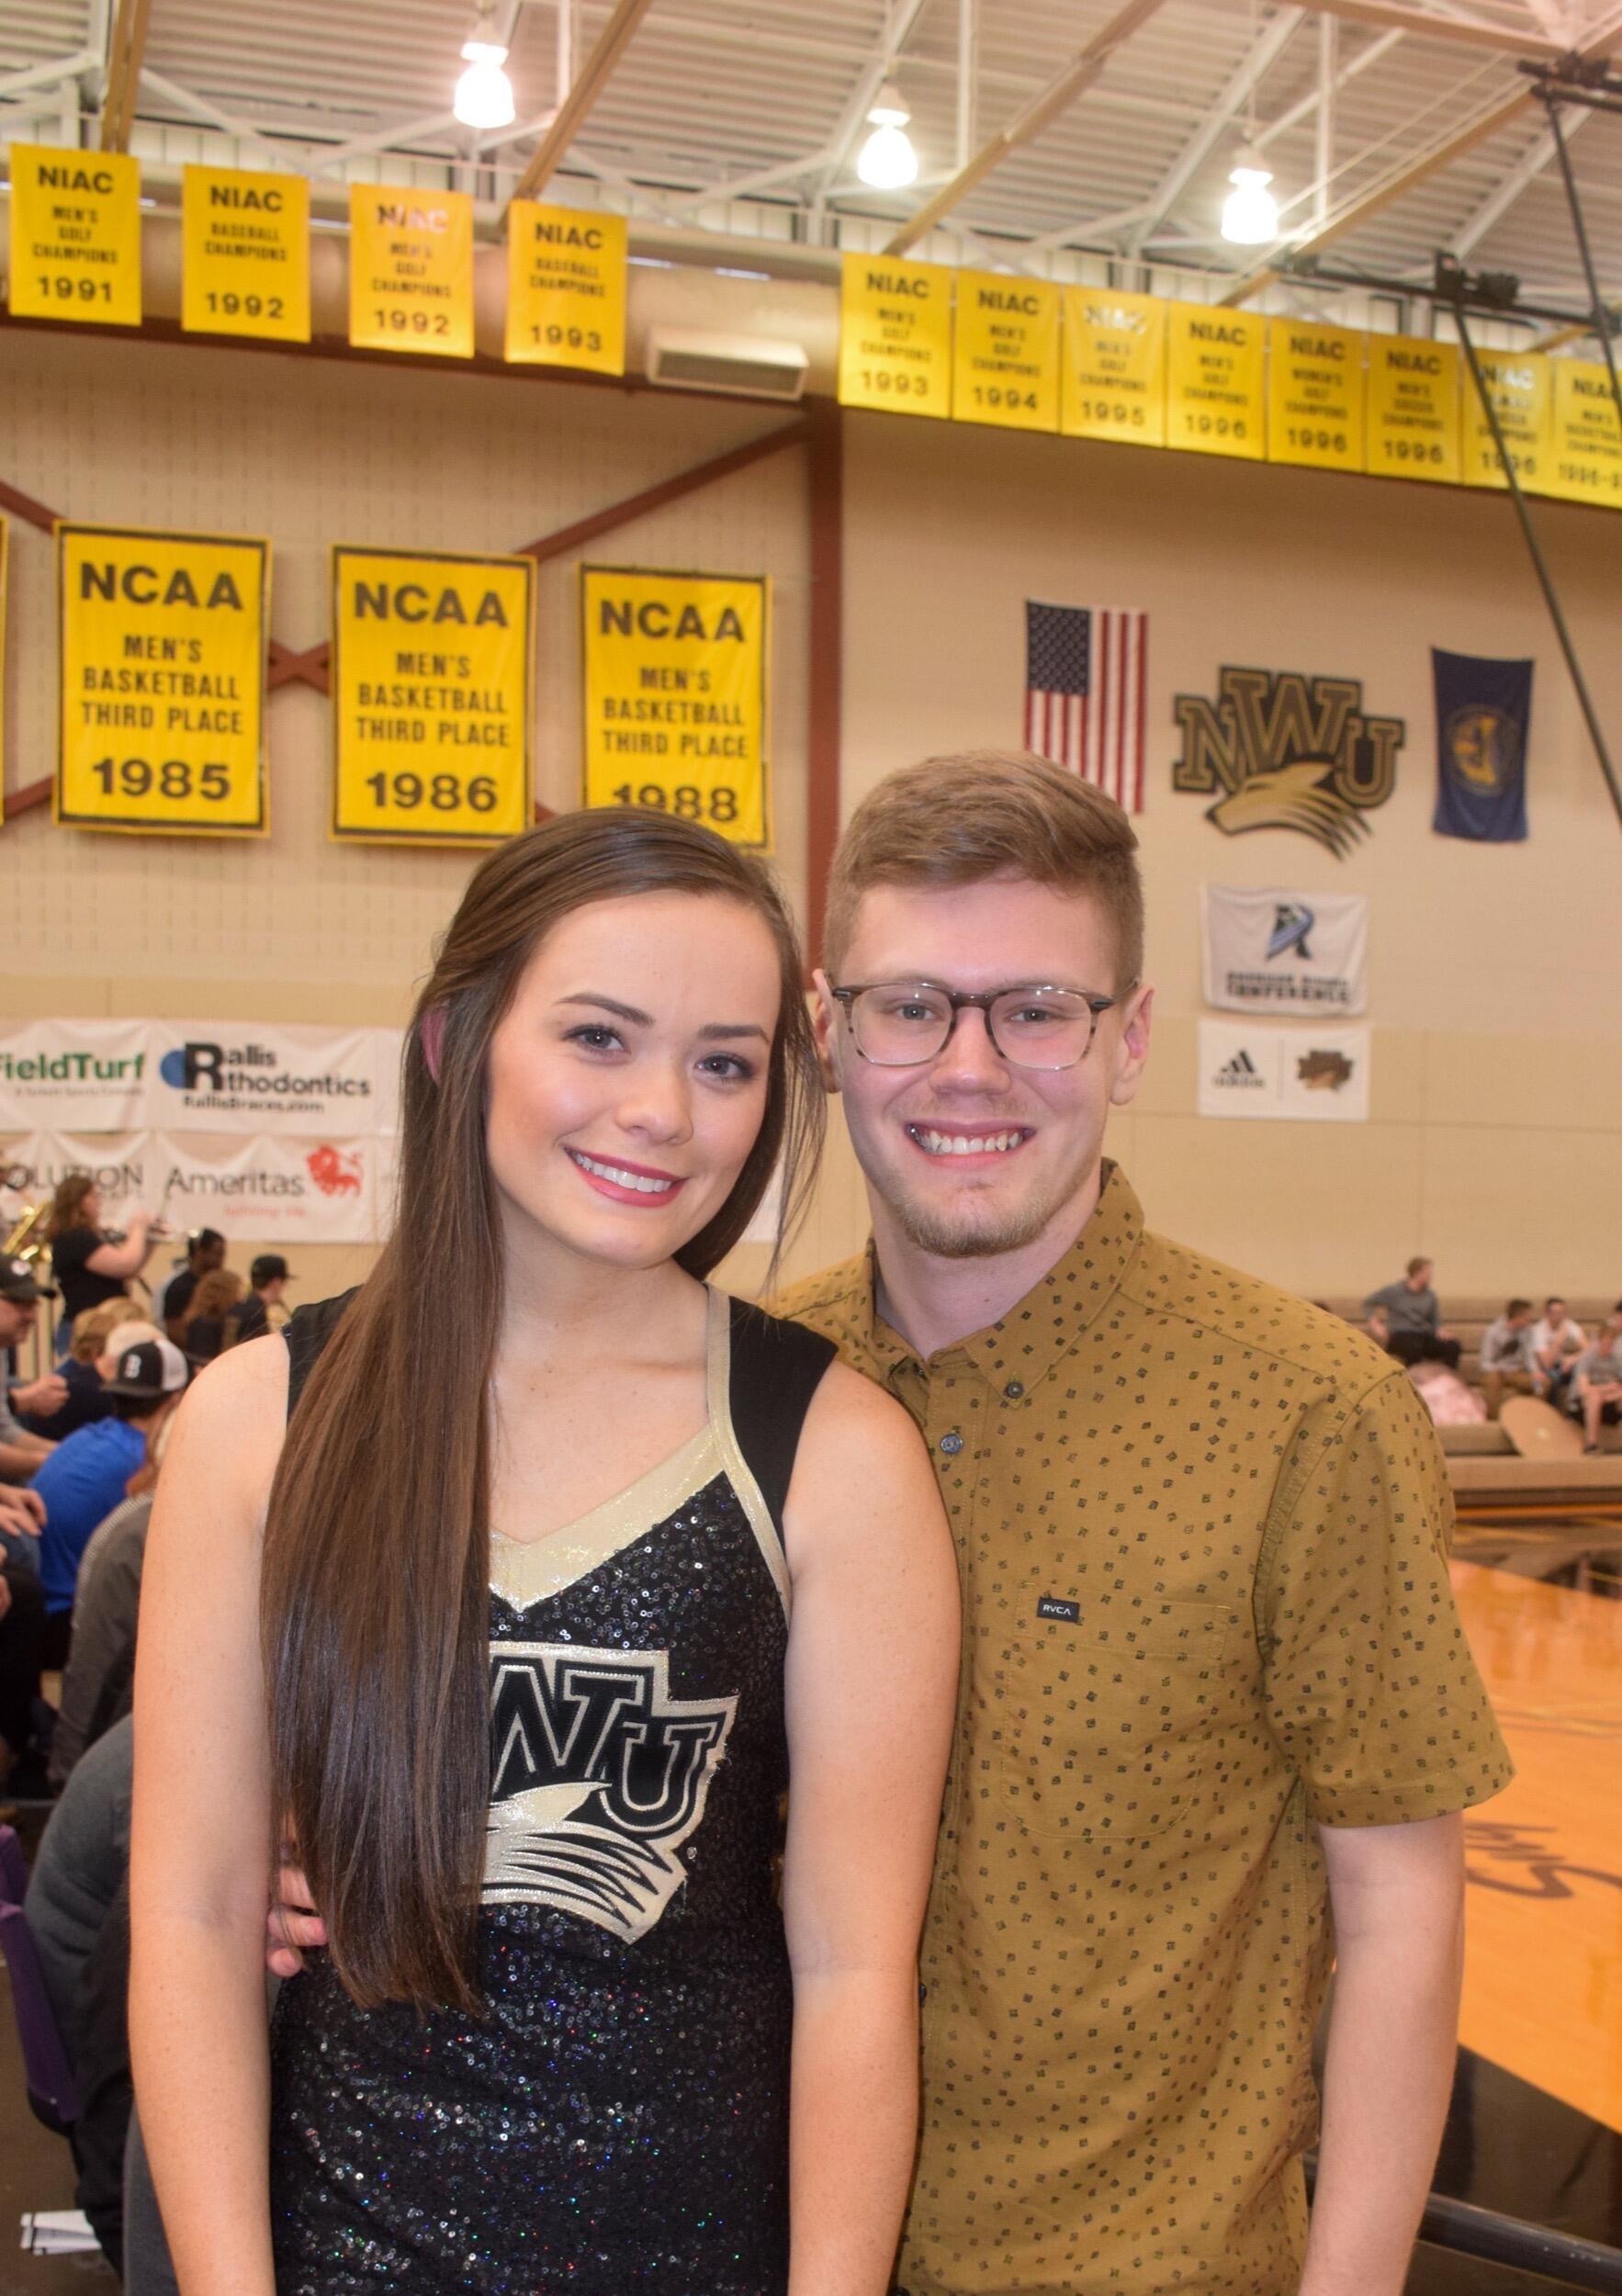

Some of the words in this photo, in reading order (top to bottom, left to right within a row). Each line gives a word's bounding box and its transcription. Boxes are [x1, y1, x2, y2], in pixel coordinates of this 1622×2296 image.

[38, 165, 114, 195] NIAC
[210, 186, 283, 212] NIAC
[535, 223, 603, 250] NIAC
[33, 243, 118, 264] CHAMPIONS
[204, 241, 287, 262] CHAMPIONS
[39, 276, 112, 302] 1991
[867, 273, 929, 298] NIAC
[207, 292, 284, 319] 1992
[978, 289, 1039, 316] NIAC
[375, 309, 450, 336] 1992
[1189, 321, 1246, 347] NIAC
[531, 324, 602, 352] 1993
[1290, 336, 1345, 362] NIAC
[1387, 350, 1441, 376] NIAC
[862, 371, 929, 397] 1993
[1572, 378, 1616, 399] NIA
[974, 387, 1037, 411] 1994
[1083, 400, 1144, 426] 1995
[1187, 414, 1246, 439] 1996
[1288, 429, 1347, 453] 1996
[1384, 440, 1443, 464] 1996
[80, 561, 243, 611] NCAA
[354, 580, 509, 628] NCAA
[600, 599, 745, 643] NCAA
[123, 634, 203, 663] MEN'S
[395, 652, 471, 679] MEN'S
[639, 666, 710, 692] MEN'S
[83, 666, 241, 700] BASKETBALL
[358, 683, 507, 715] BASKETBALL
[603, 697, 743, 726] BASKETBALL
[81, 701, 153, 729] THIRD
[167, 707, 242, 735] PLACE
[356, 715, 425, 743] THIRD
[438, 721, 510, 748] PLACE
[602, 729, 669, 756] THIRD
[681, 734, 749, 759] PLACE
[1173, 664, 1406, 809] NWU
[93, 757, 231, 801] 1985
[366, 771, 499, 813] 1986
[613, 783, 738, 823] 1988
[167, 1166, 305, 1195] Ameritas
[1042, 1604, 1072, 1615] RVCA
[490, 1655, 728, 1840] WU
